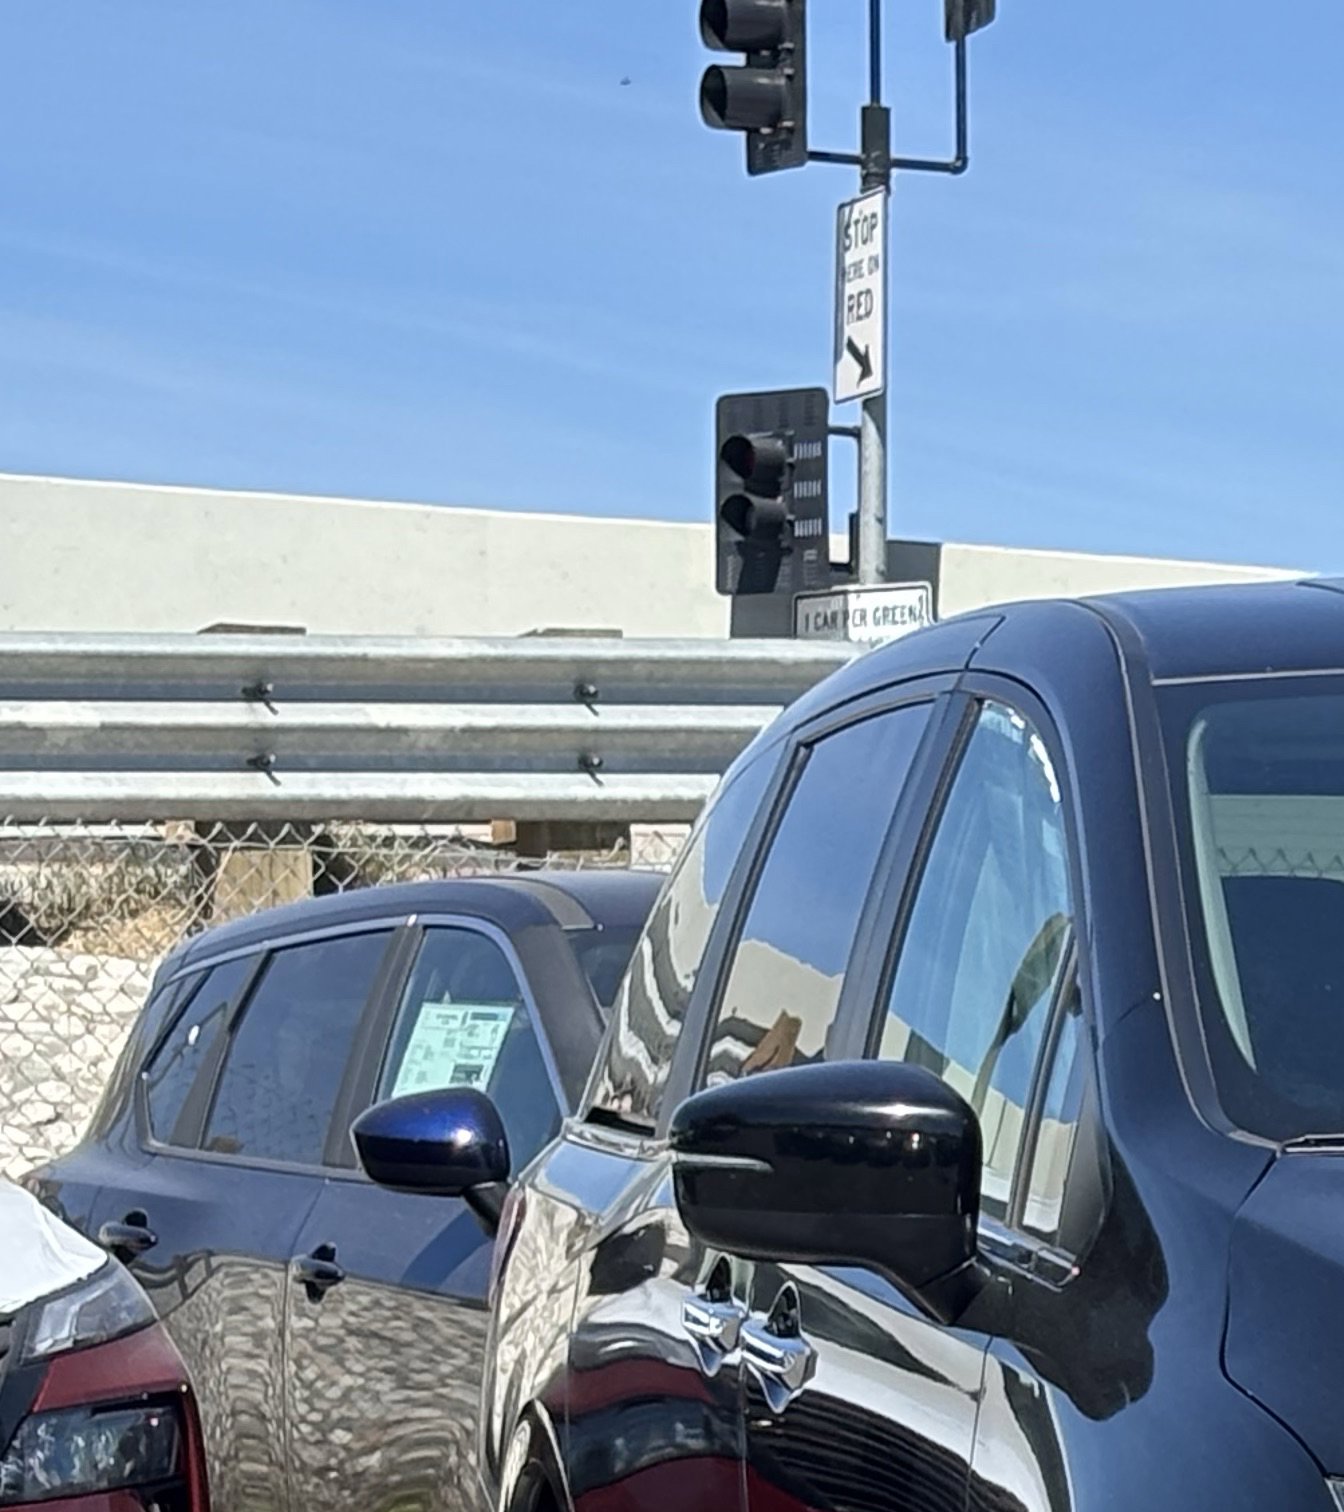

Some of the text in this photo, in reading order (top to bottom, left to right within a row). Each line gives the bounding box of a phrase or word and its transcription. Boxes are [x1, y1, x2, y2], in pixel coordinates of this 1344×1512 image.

[843, 211, 878, 253] STOP
[847, 288, 874, 326] RED
[873, 604, 918, 627] GREEN
